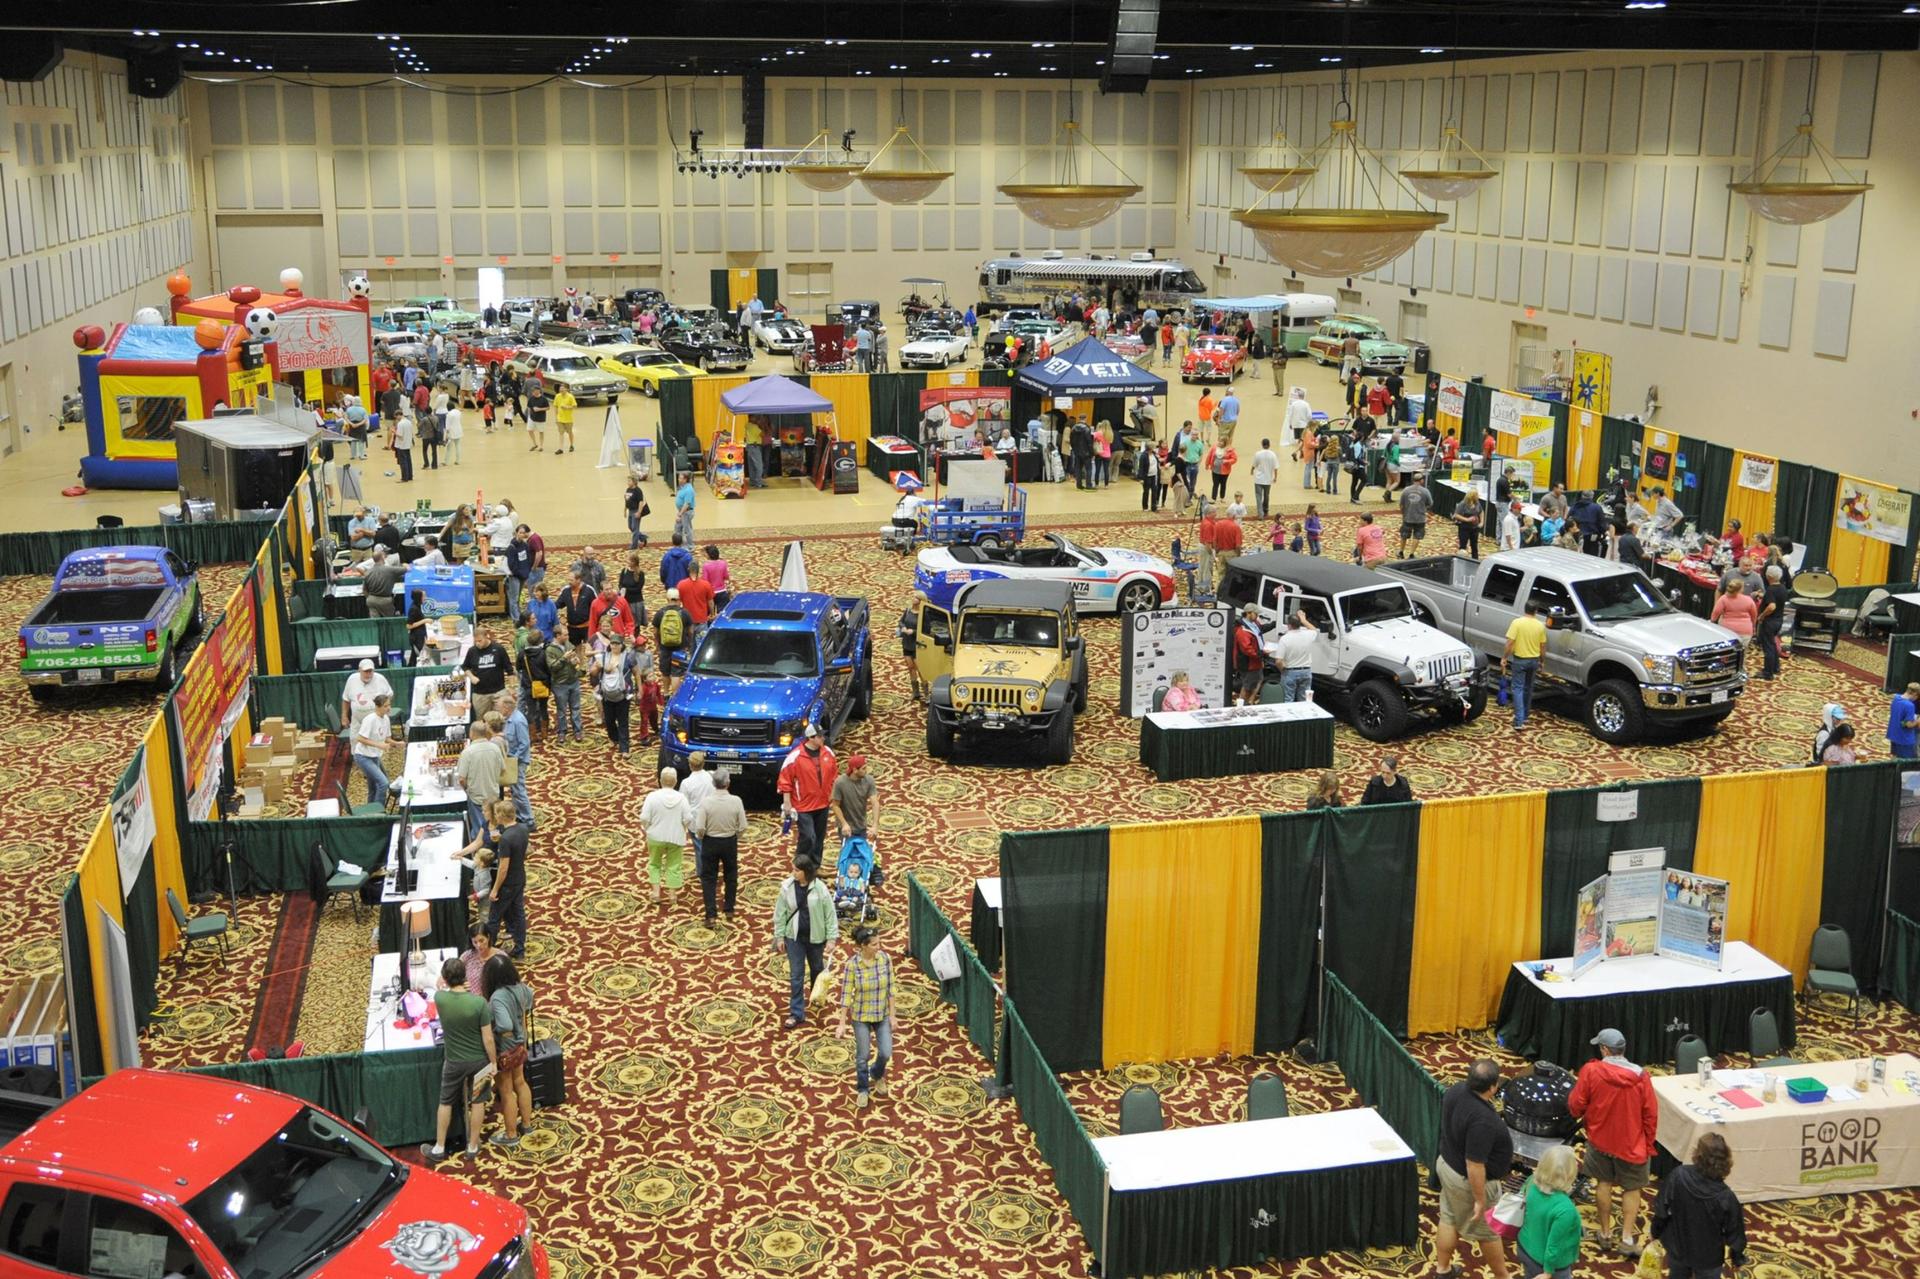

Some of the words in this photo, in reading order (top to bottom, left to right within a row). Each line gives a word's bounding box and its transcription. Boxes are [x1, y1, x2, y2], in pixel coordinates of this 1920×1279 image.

[279, 347, 353, 369] EORGIA
[1044, 357, 1072, 373] YETI
[1074, 362, 1131, 376] YETI
[35, 655, 141, 667] 706-254-8543
[1802, 1117, 1881, 1146] FOOD
[1801, 1140, 1878, 1170] BANK
